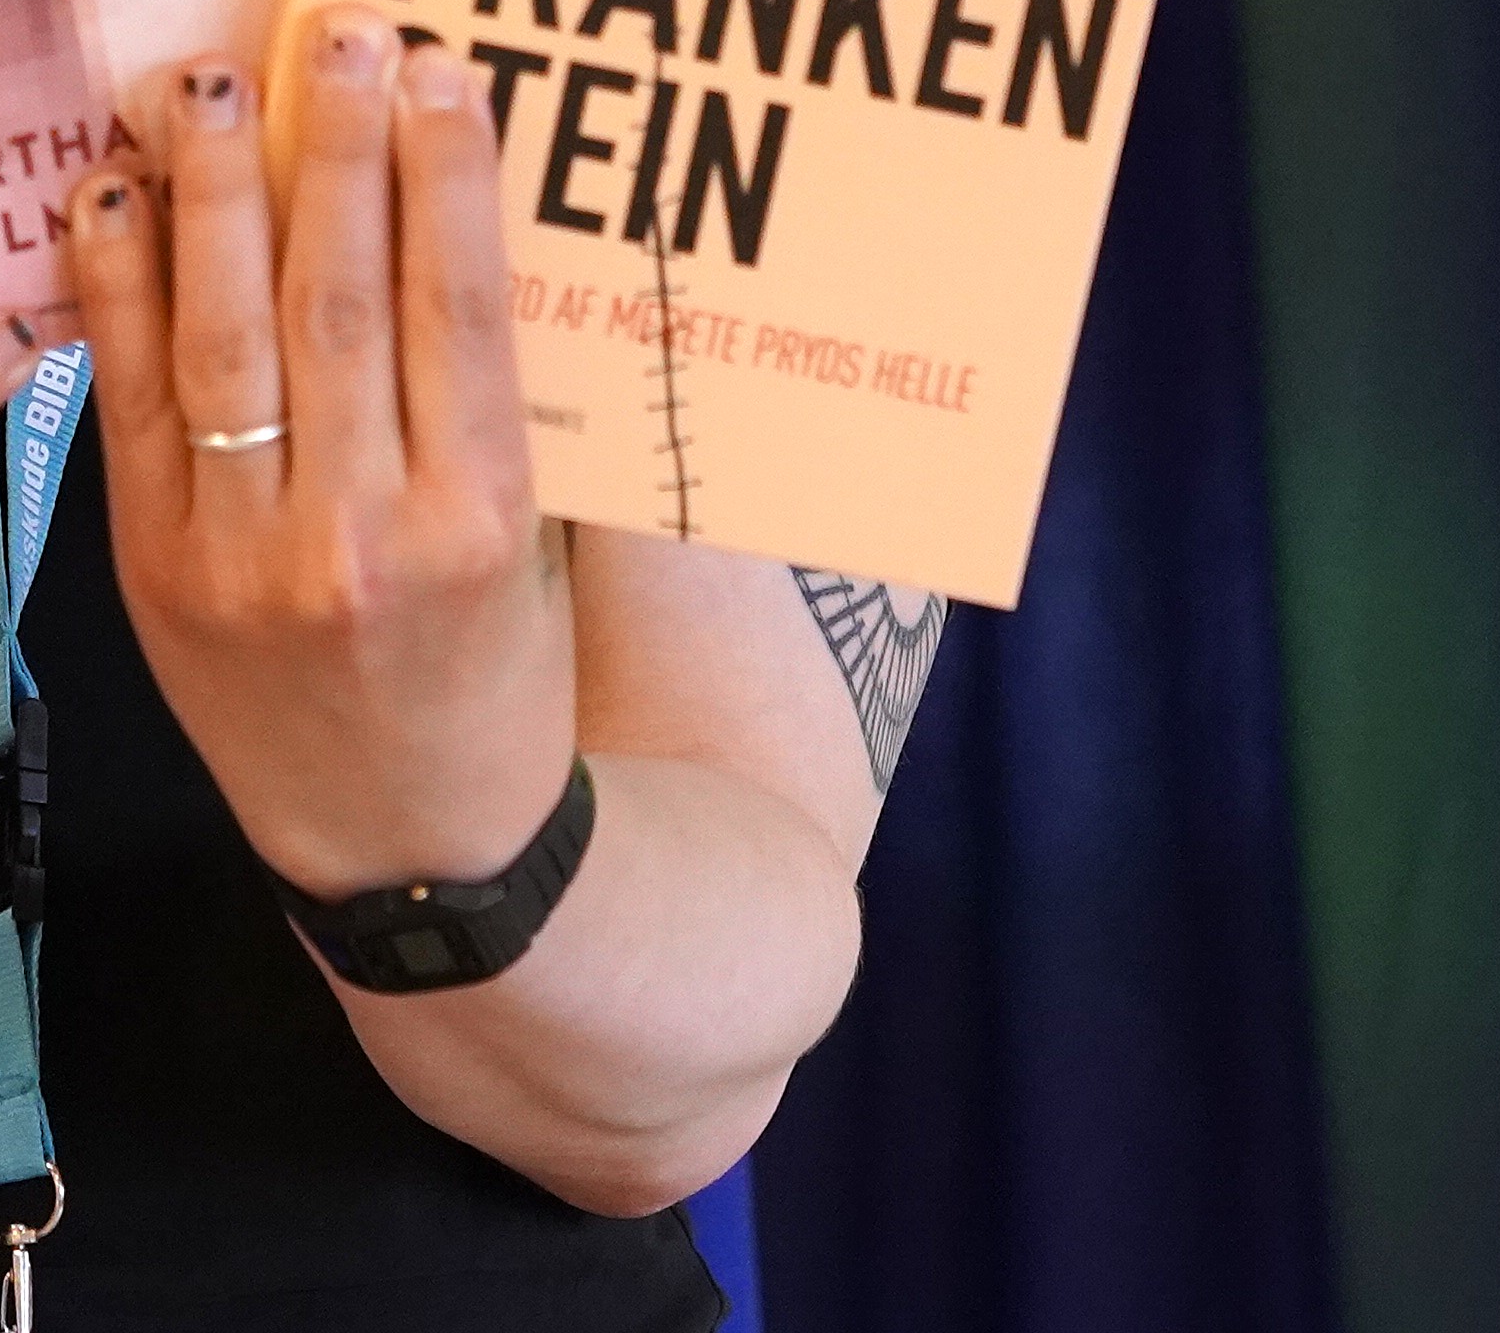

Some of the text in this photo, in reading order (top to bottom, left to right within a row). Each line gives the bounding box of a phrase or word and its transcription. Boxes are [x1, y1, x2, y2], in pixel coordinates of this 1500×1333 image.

[396, 23, 790, 267] TEIN
[24, 339, 86, 437] BIBL
[550, 284, 599, 331] AF
[606, 295, 746, 367] MERETE
[750, 323, 867, 390] PRYDS
[870, 349, 978, 415] HELLE
